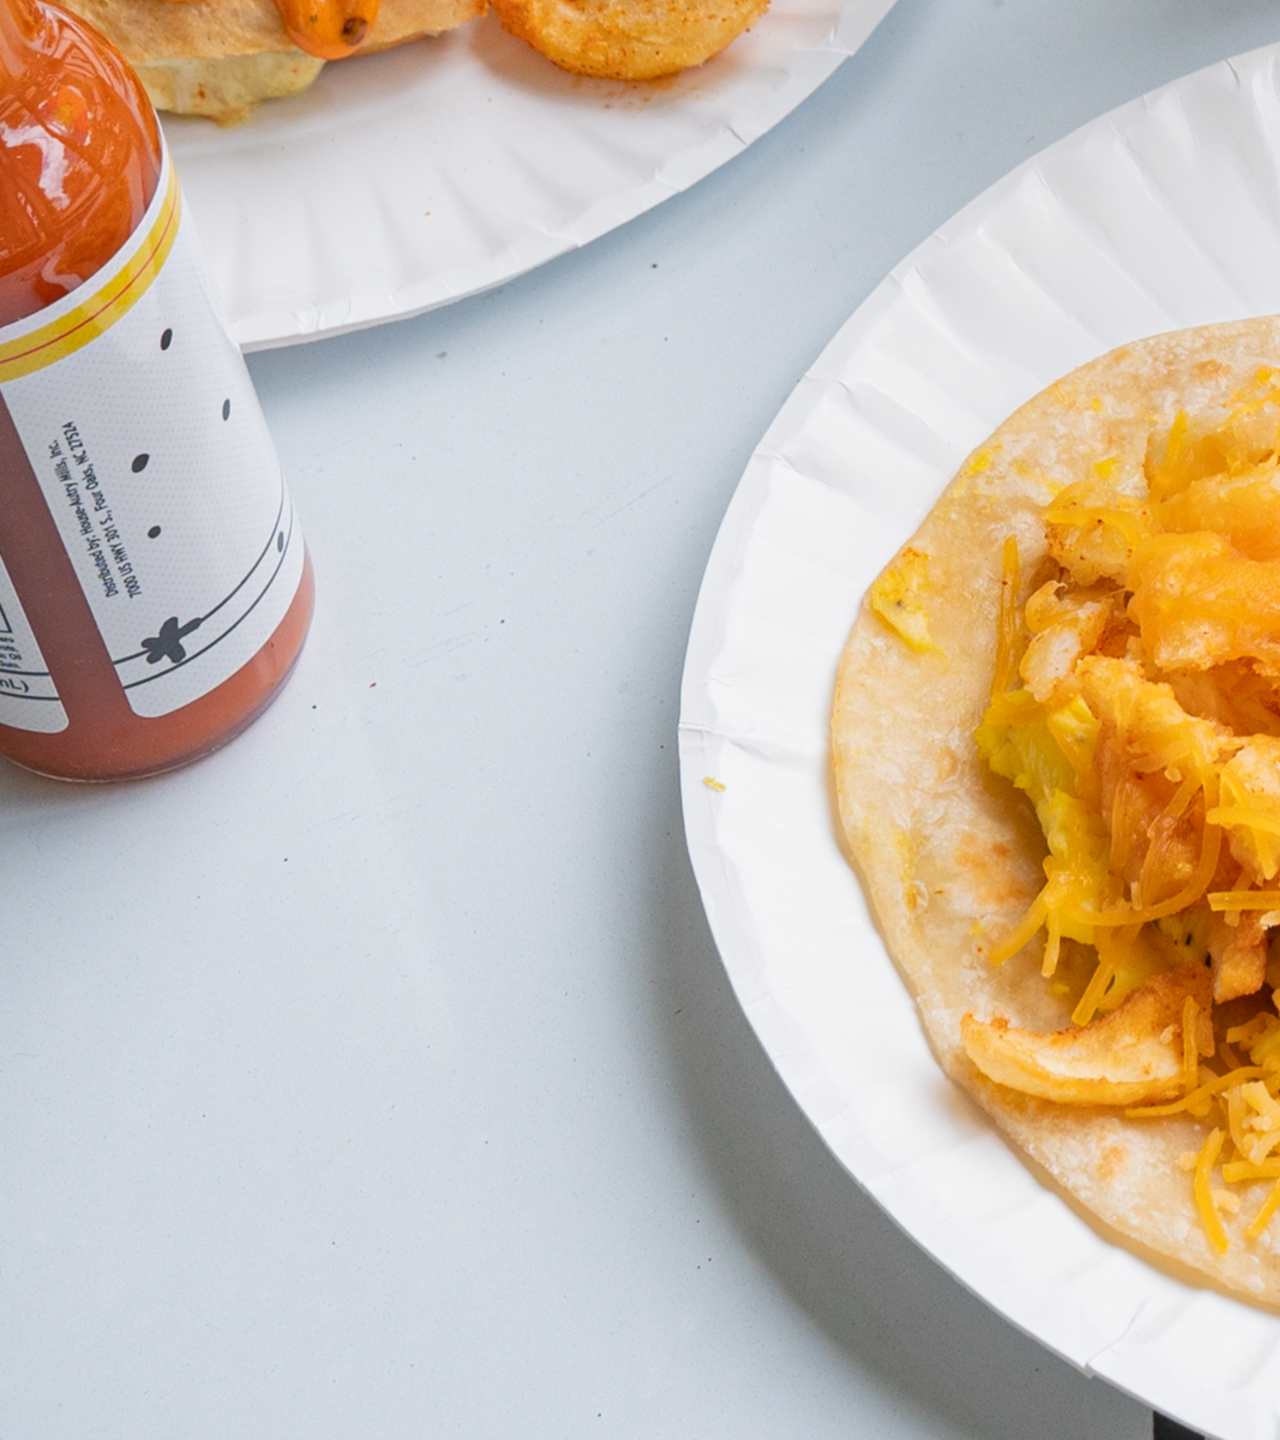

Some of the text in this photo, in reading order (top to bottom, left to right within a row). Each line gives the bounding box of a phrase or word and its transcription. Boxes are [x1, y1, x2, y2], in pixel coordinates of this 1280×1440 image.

[48, 440, 62, 459] Inc.
[73, 449, 89, 466] NC
[92, 490, 107, 513] Four
[102, 524, 120, 543] 301
[93, 547, 119, 598] Distributed
